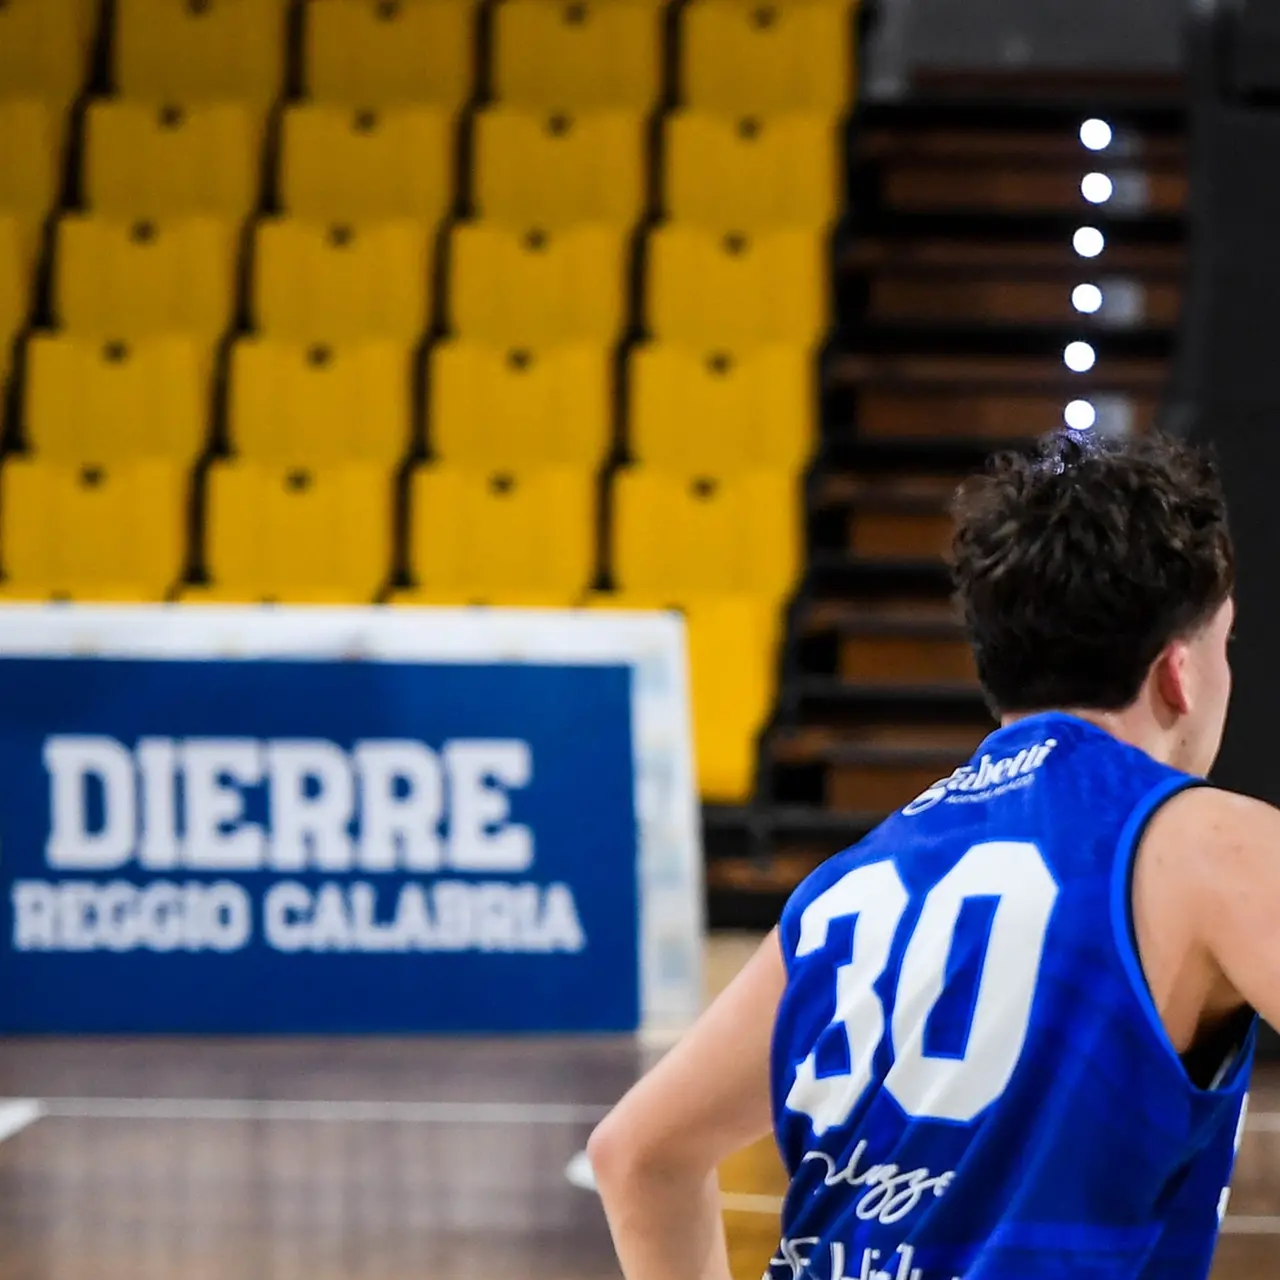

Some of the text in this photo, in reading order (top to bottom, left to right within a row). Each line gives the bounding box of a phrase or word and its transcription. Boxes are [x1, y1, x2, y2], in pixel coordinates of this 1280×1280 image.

[42, 734, 535, 872] DIERRE
[12, 878, 588, 954] REGGIO CALABRIA
[785, 841, 1060, 1137] 30
